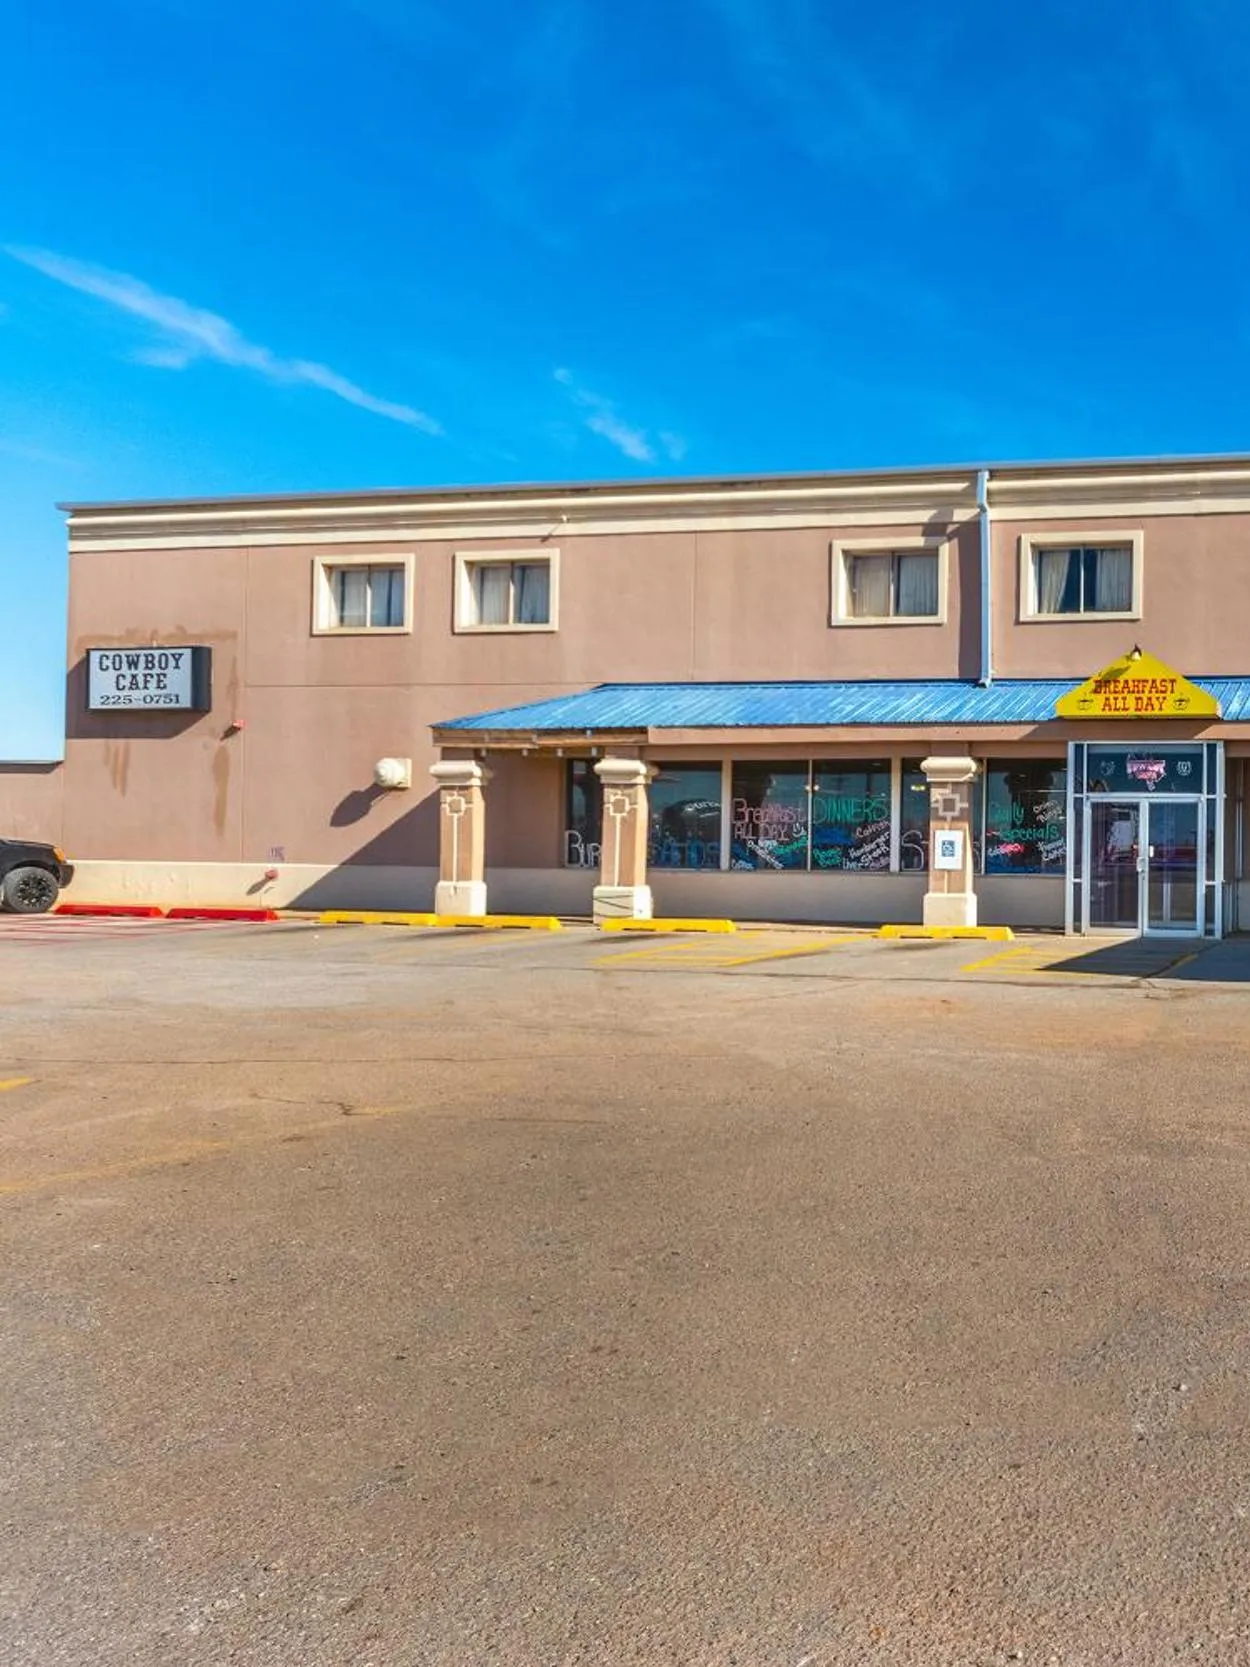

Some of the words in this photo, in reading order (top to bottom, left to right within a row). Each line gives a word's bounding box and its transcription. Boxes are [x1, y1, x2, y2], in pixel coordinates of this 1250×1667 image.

[99, 653, 185, 671] COWBOY
[115, 673, 168, 691] CAFE
[1093, 679, 1177, 694] BREAKFAST
[99, 693, 181, 706] 225-0751
[1101, 696, 1130, 712] ALL
[1135, 696, 1167, 712] DAY
[813, 797, 889, 824] DINNERS
